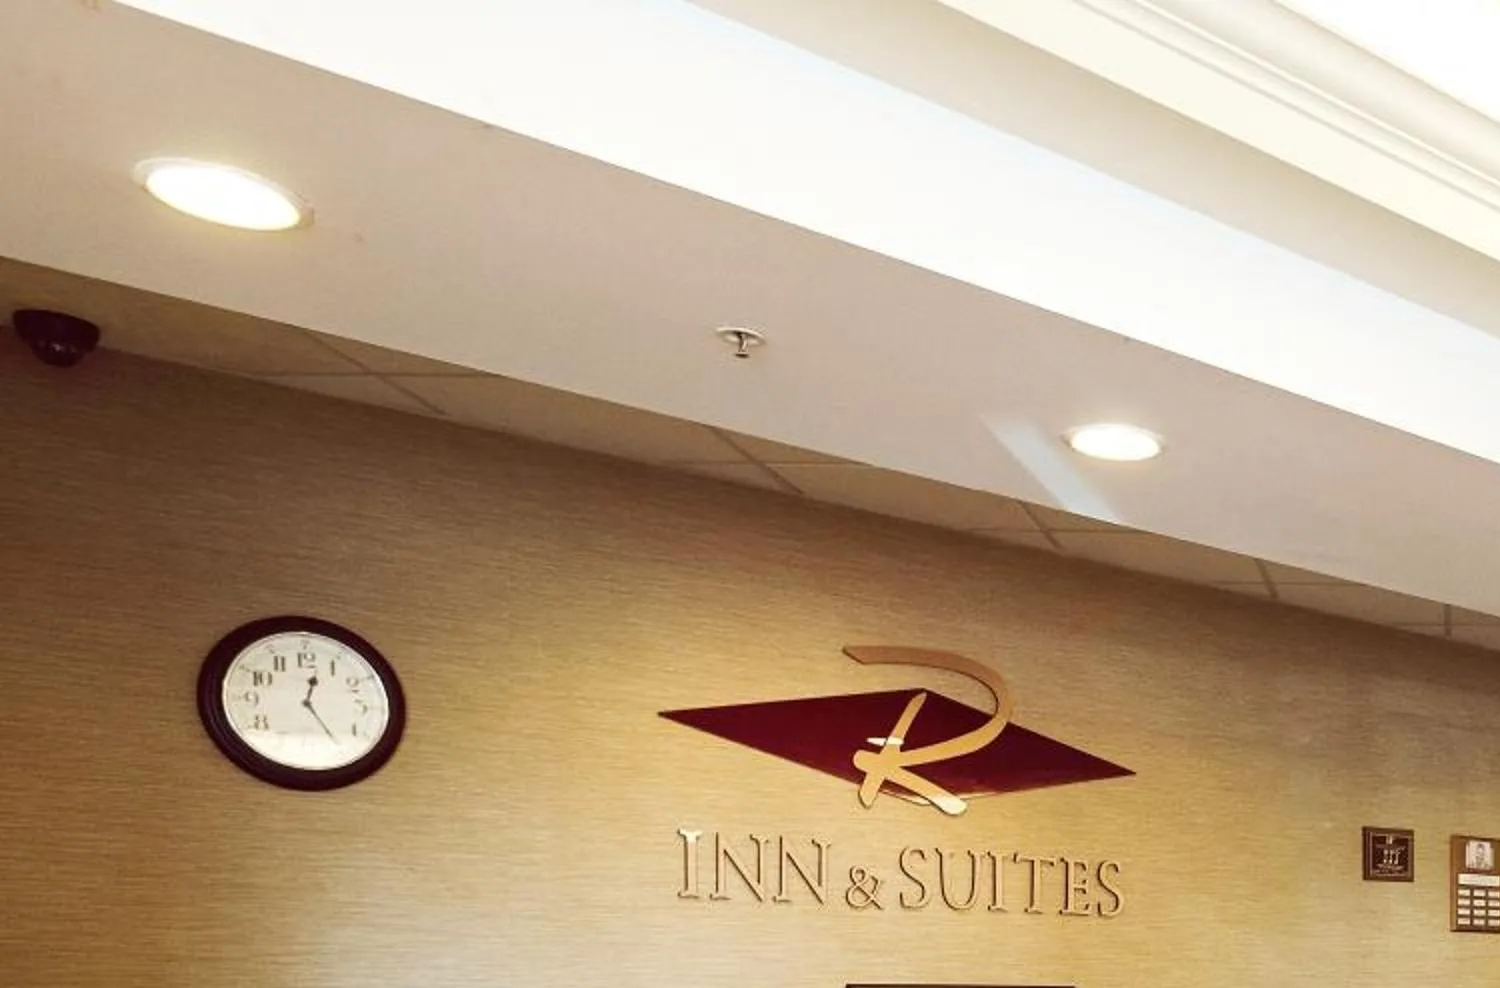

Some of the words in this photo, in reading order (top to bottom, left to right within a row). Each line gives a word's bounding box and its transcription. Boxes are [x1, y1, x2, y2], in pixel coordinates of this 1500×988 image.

[273, 656, 286, 672] 11
[297, 652, 316, 668] 12
[253, 671, 273, 687] 10
[677, 827, 831, 906] INN
[844, 864, 885, 911] &
[899, 845, 1126, 919] SUITES
